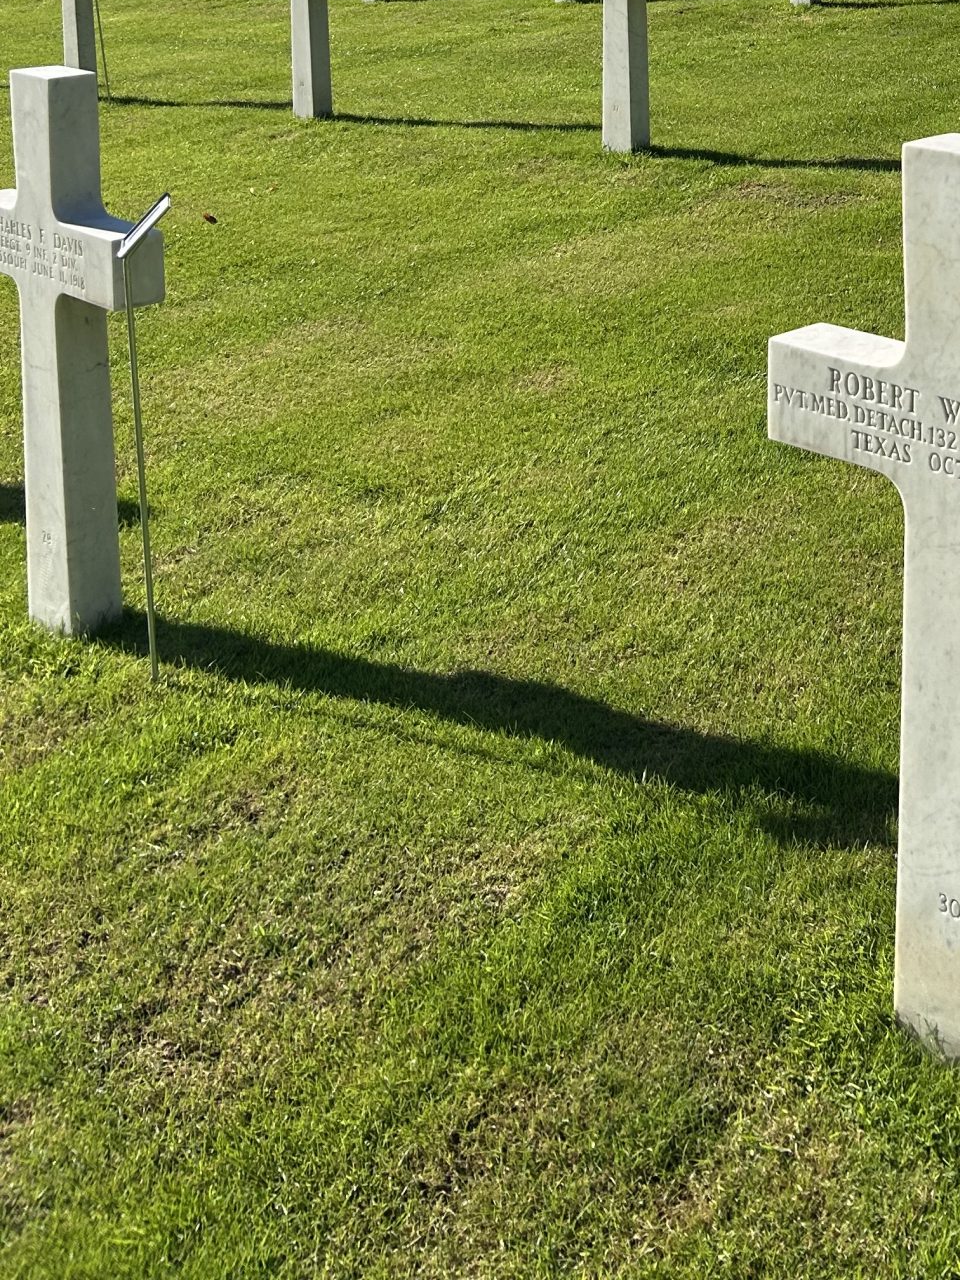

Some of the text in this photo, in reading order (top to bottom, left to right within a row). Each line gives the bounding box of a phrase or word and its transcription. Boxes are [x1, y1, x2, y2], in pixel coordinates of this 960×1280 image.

[54, 233, 83, 257] DAVIS
[32, 263, 54, 279] JUNE
[70, 273, 86, 290] 1918
[829, 367, 920, 414] ROBERT
[774, 383, 810, 411] PVT.
[811, 395, 852, 422] MED.
[854, 405, 927, 443] DETACH.
[928, 426, 958, 450] 132
[851, 431, 912, 464] TEXAS
